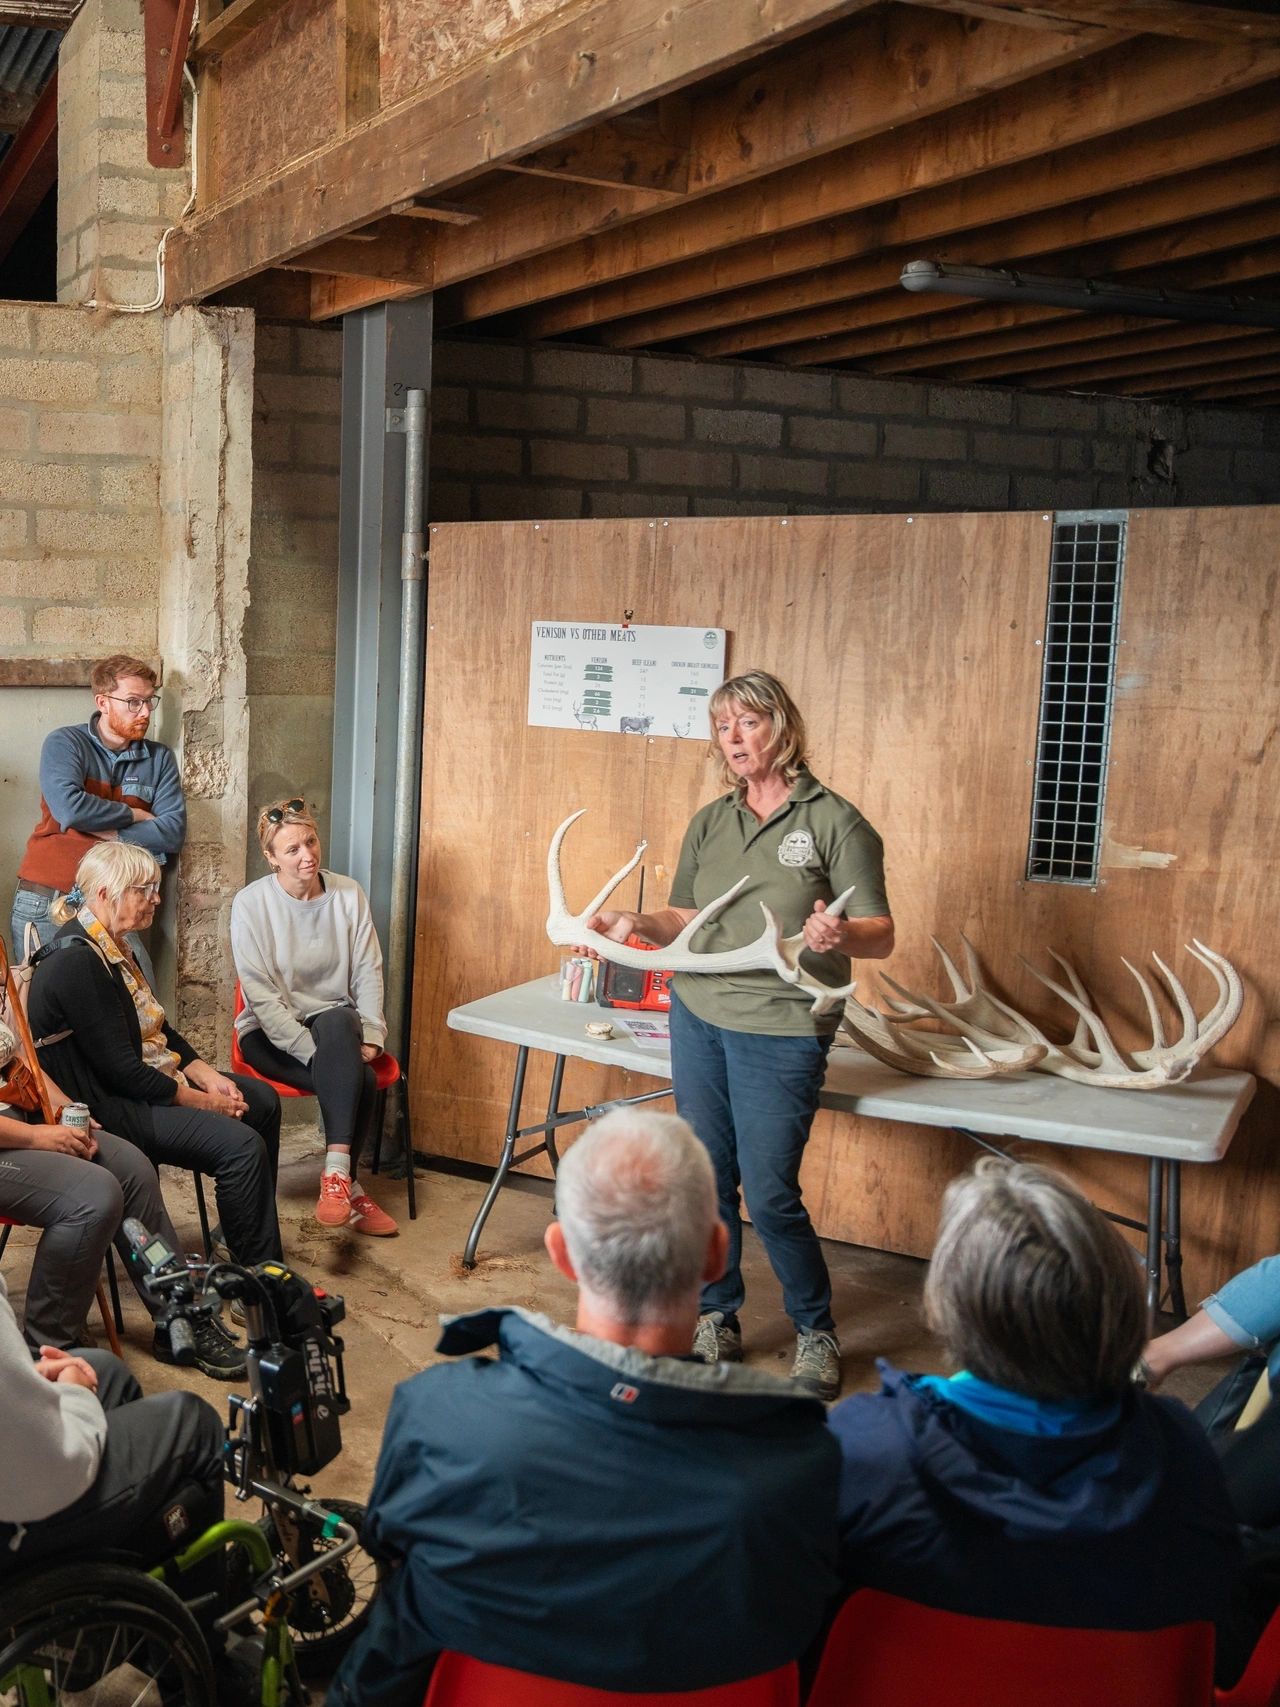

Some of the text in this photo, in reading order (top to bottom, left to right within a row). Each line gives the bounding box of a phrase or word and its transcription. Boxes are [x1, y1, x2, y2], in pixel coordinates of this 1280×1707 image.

[536, 626, 636, 642] VENISON VS OTHER MEATS
